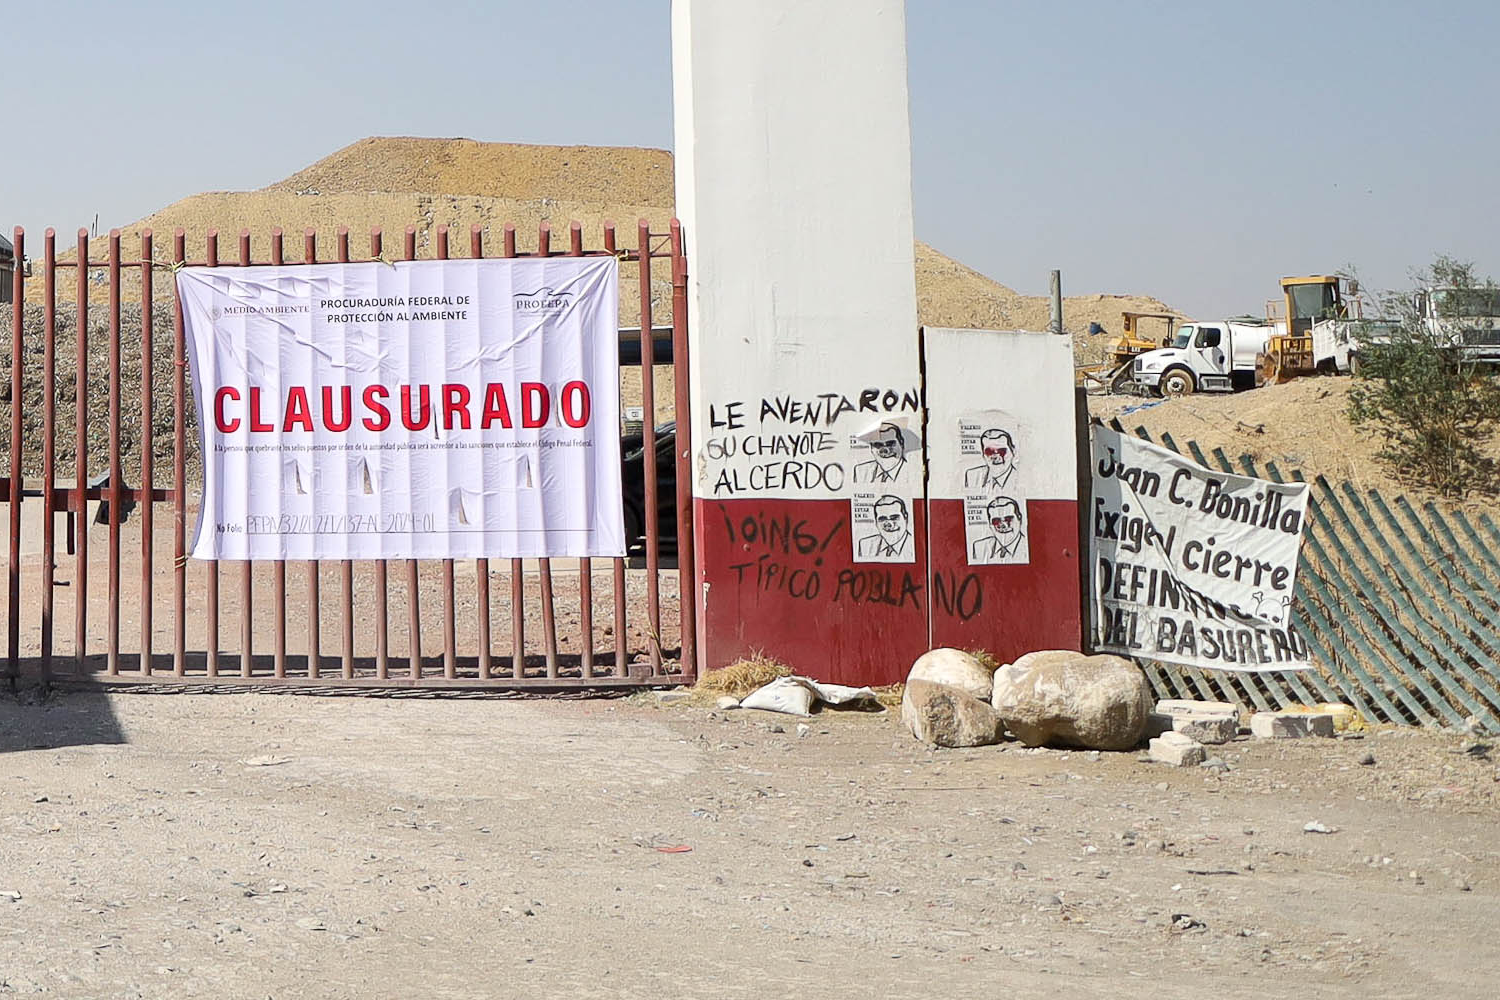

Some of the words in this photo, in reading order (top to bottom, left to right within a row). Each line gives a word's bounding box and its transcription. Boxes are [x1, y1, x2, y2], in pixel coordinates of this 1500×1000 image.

[224, 306, 256, 314] MEDIO
[259, 304, 310, 313] AMBIENTE
[320, 296, 405, 308] PROCURADURÍA
[408, 296, 453, 306] FEDERAL
[456, 295, 470, 304] DE
[327, 311, 393, 323] PROTECCIÓN
[396, 313, 409, 321] AL
[412, 311, 467, 321] AMBIENTE
[213, 380, 591, 433] CLAUSURADO
[710, 402, 745, 430] LE
[759, 388, 920, 428] AVENTARON
[742, 431, 839, 458] CHAYOTE
[1098, 447, 1161, 498] Juan
[1169, 468, 1193, 508] C.
[1199, 478, 1301, 535] Bonilla
[1181, 536, 1290, 591] cierre
[1156, 615, 1311, 664] BASURERO
